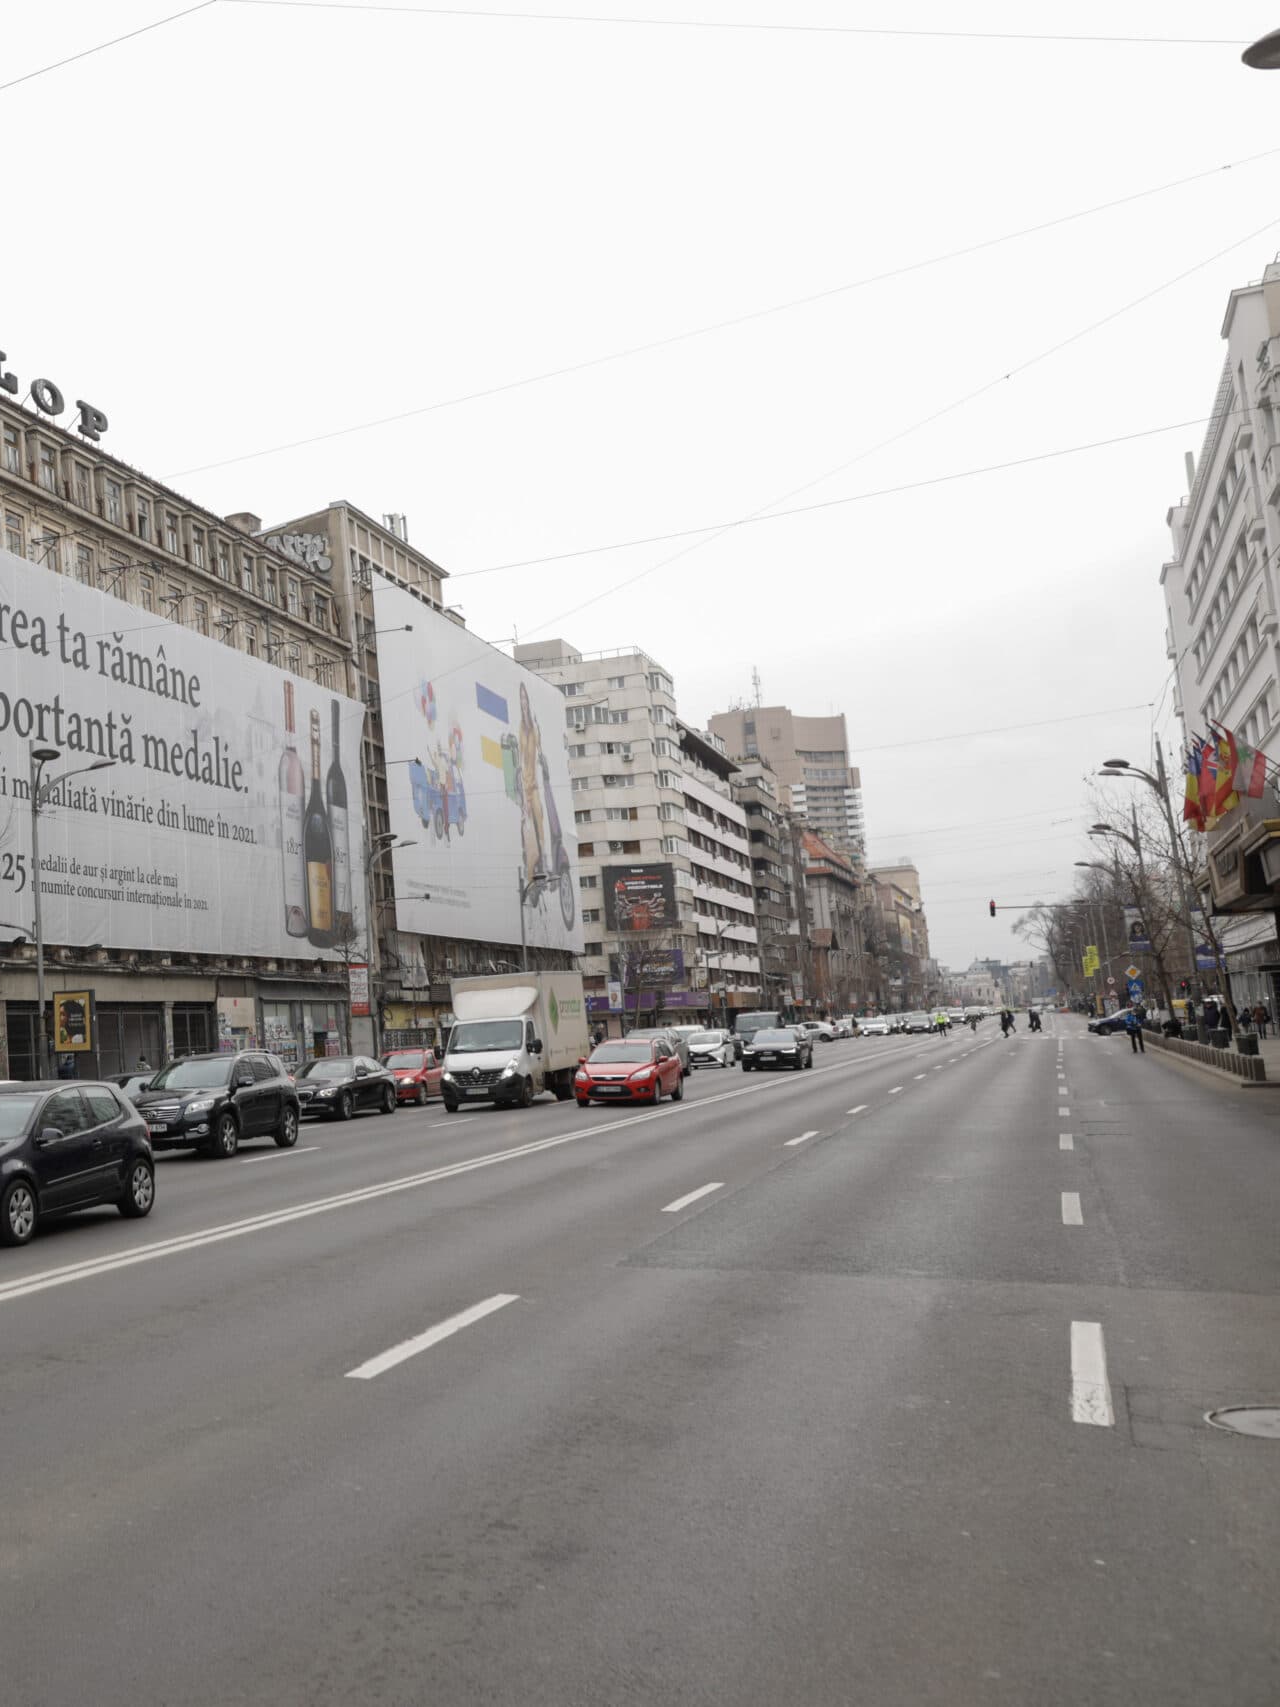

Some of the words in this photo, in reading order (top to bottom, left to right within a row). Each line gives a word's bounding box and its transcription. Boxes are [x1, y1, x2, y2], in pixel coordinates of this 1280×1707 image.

[57, 613, 90, 670] ta
[96, 632, 201, 708] rămâne
[141, 729, 249, 794] medalie.
[12, 774, 98, 814] mdaliată
[102, 789, 153, 824] vinărie
[157, 799, 180, 829] din
[182, 804, 214, 836] lume
[217, 812, 230, 839] în
[70, 858, 81, 875] de
[83, 864, 98, 878] aur
[110, 865, 136, 885] argint
[137, 866, 145, 883] la
[146, 869, 162, 886] cele
[163, 873, 178, 888] mai
[77, 883, 125, 901] concursuri
